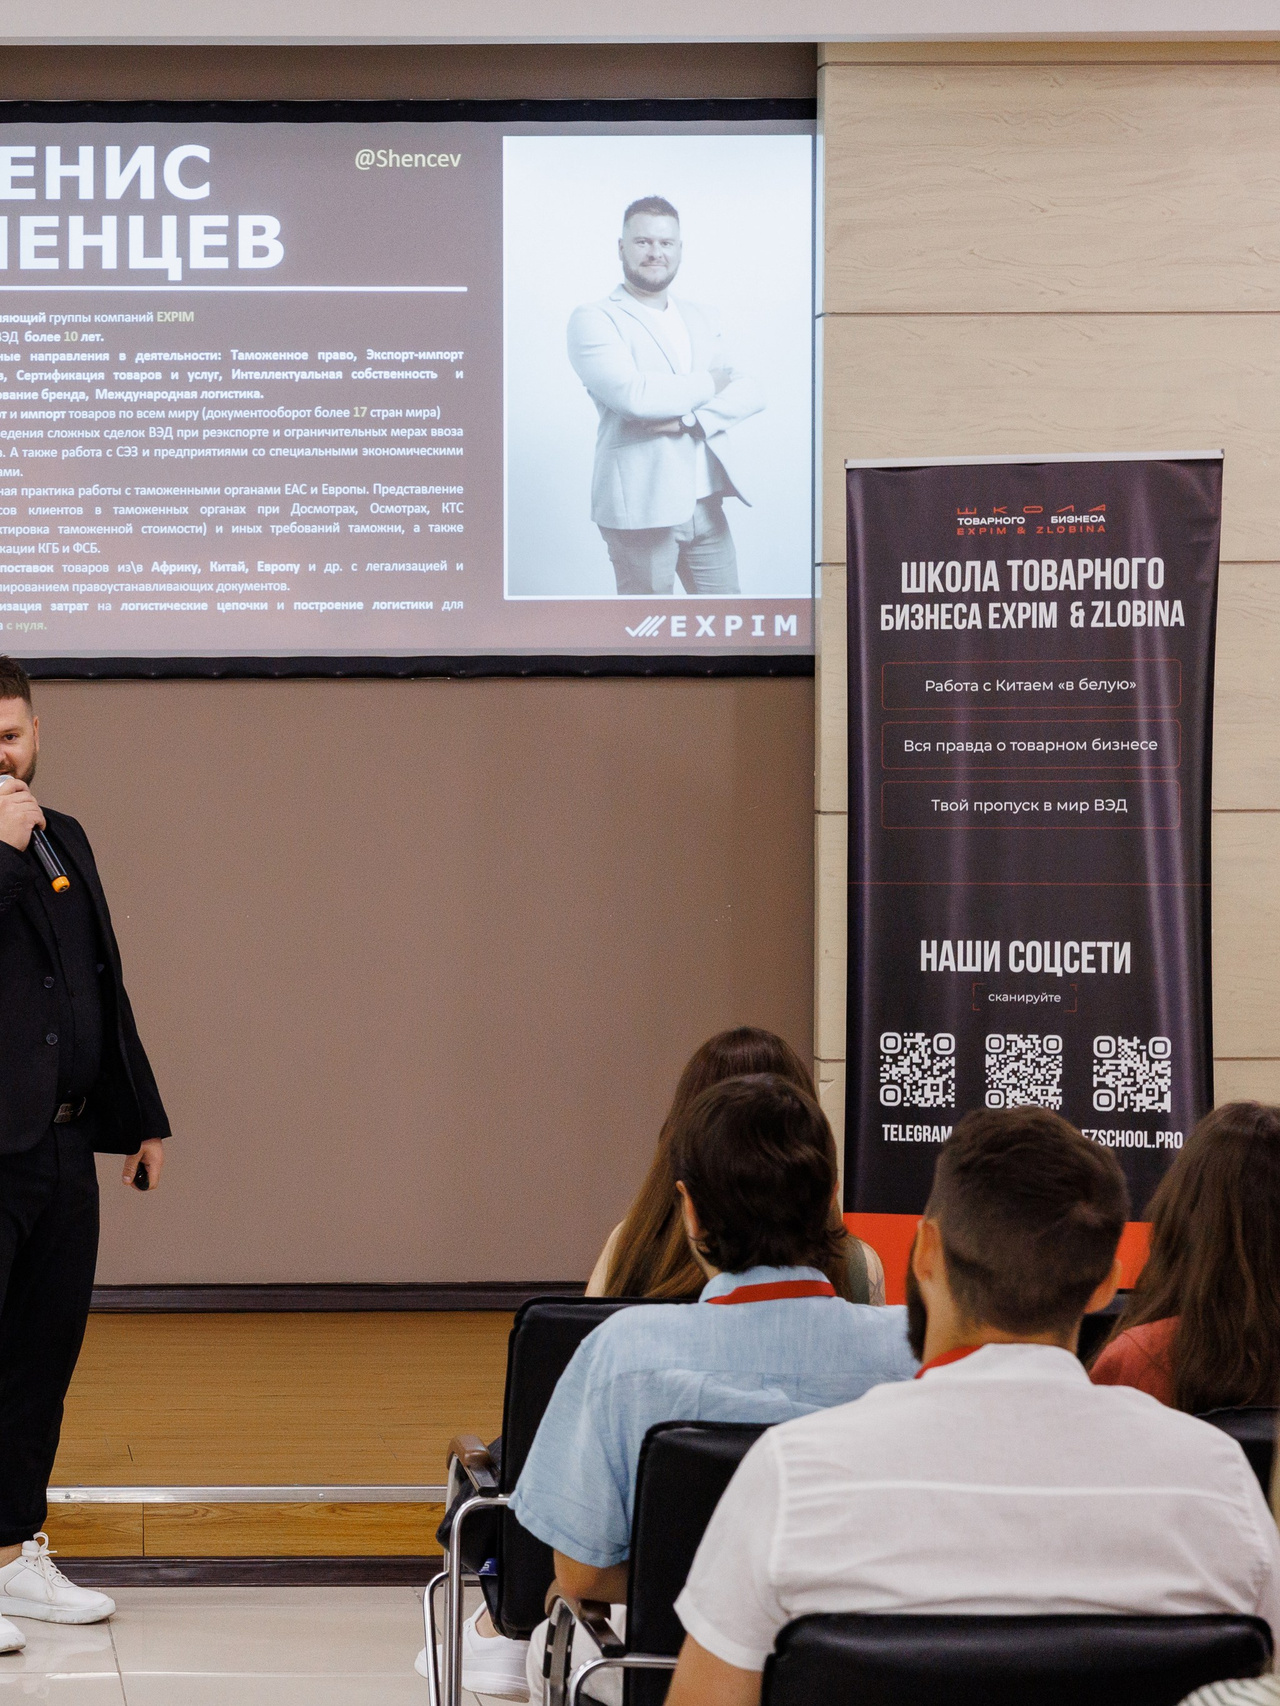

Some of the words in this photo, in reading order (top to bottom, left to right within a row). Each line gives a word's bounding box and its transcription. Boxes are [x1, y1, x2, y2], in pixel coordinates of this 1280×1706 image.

[355, 149, 461, 170] @Shencev
[48, 314, 92, 326] группы
[93, 311, 154, 323] компаний
[156, 311, 195, 322] EXPIM
[24, 330, 62, 343] более
[64, 330, 79, 342] 10
[80, 333, 105, 342] лет.
[29, 352, 110, 365] направления
[118, 352, 127, 362] в
[134, 351, 222, 364] деятельности:
[230, 348, 309, 361] Таможенное
[317, 351, 358, 363] право,
[366, 348, 465, 363] Экспорт-импорт
[15, 368, 106, 384] Сертификация
[112, 371, 163, 384] товаров
[170, 371, 180, 380] и
[186, 371, 223, 383] услуг,
[231, 368, 343, 383] Интеллектуальная
[350, 366, 439, 380] собственность
[455, 370, 464, 379] и
[40, 387, 90, 403] бренда,
[95, 388, 198, 403] Международная
[199, 390, 265, 400] логистика.
[20, 487, 75, 500] практика
[77, 483, 122, 499] работы
[124, 487, 132, 496] с
[133, 486, 221, 496] таможенными
[223, 486, 282, 498] органами
[284, 483, 308, 496] ЕАС
[310, 486, 319, 495] и
[321, 483, 370, 498] Европы.
[372, 482, 464, 498] Представление
[28, 506, 84, 516] клиентов
[94, 506, 103, 516] в
[112, 506, 189, 515] таможенных
[199, 505, 247, 518] органах
[257, 505, 280, 517] при
[289, 502, 359, 517] Досмотрах,
[369, 502, 431, 517] Осмотрах,
[441, 501, 464, 514] КТС
[957, 504, 1106, 515] ШКОЛА
[957, 517, 1025, 525] ТОВАРНОГО
[1051, 515, 1106, 523] БИЗНЕСА
[57, 522, 134, 535] таможенной
[140, 521, 208, 537] стоимости)
[215, 525, 224, 534] и
[231, 524, 263, 534] иных
[269, 521, 341, 537] требований
[347, 524, 405, 535] таможни,
[413, 524, 421, 533] а
[427, 523, 464, 533] также
[957, 527, 1007, 536] EXPIM
[1036, 525, 1106, 534] ZLOBINA
[37, 542, 60, 554] КГБ
[61, 545, 71, 554] и
[72, 541, 101, 554] ФСБ.
[901, 561, 1000, 593] ШКОЛА
[1007, 557, 1164, 592] ТОВАРНОГО
[71, 582, 215, 595] правоустанавливающих
[215, 582, 291, 595] документов.
[50, 602, 90, 614] затрат
[97, 602, 112, 611] на
[119, 601, 209, 611] логистические
[216, 601, 269, 614] цепочки
[276, 601, 285, 611] и
[293, 601, 364, 613] построение
[371, 601, 434, 610] логистики
[441, 600, 464, 612] для
[881, 602, 982, 630] БИЗНЕСА
[988, 602, 1057, 629] EXPIM
[1070, 602, 1085, 628] &
[1091, 600, 1184, 628] ZLOBINA
[671, 615, 796, 637] EXPIM
[925, 679, 978, 692] Работа
[983, 682, 992, 692] с
[996, 679, 1053, 692] Китаем
[1058, 680, 1074, 691] «в
[1079, 678, 1136, 693] белую»
[904, 740, 931, 752] Вся
[936, 741, 992, 754] правда
[997, 742, 1006, 751] о
[1010, 741, 1087, 754] товарном
[1092, 738, 1158, 751] бизнесе
[932, 799, 968, 812] Твой
[973, 800, 1039, 815] пропуск
[1044, 801, 1052, 812] в
[1057, 801, 1089, 815] мир
[1094, 799, 1128, 814] ВЭД
[920, 940, 1000, 972] НАШИ
[1009, 941, 1131, 976] СОЦСЕТИ
[988, 992, 1061, 1004] сканируйте
